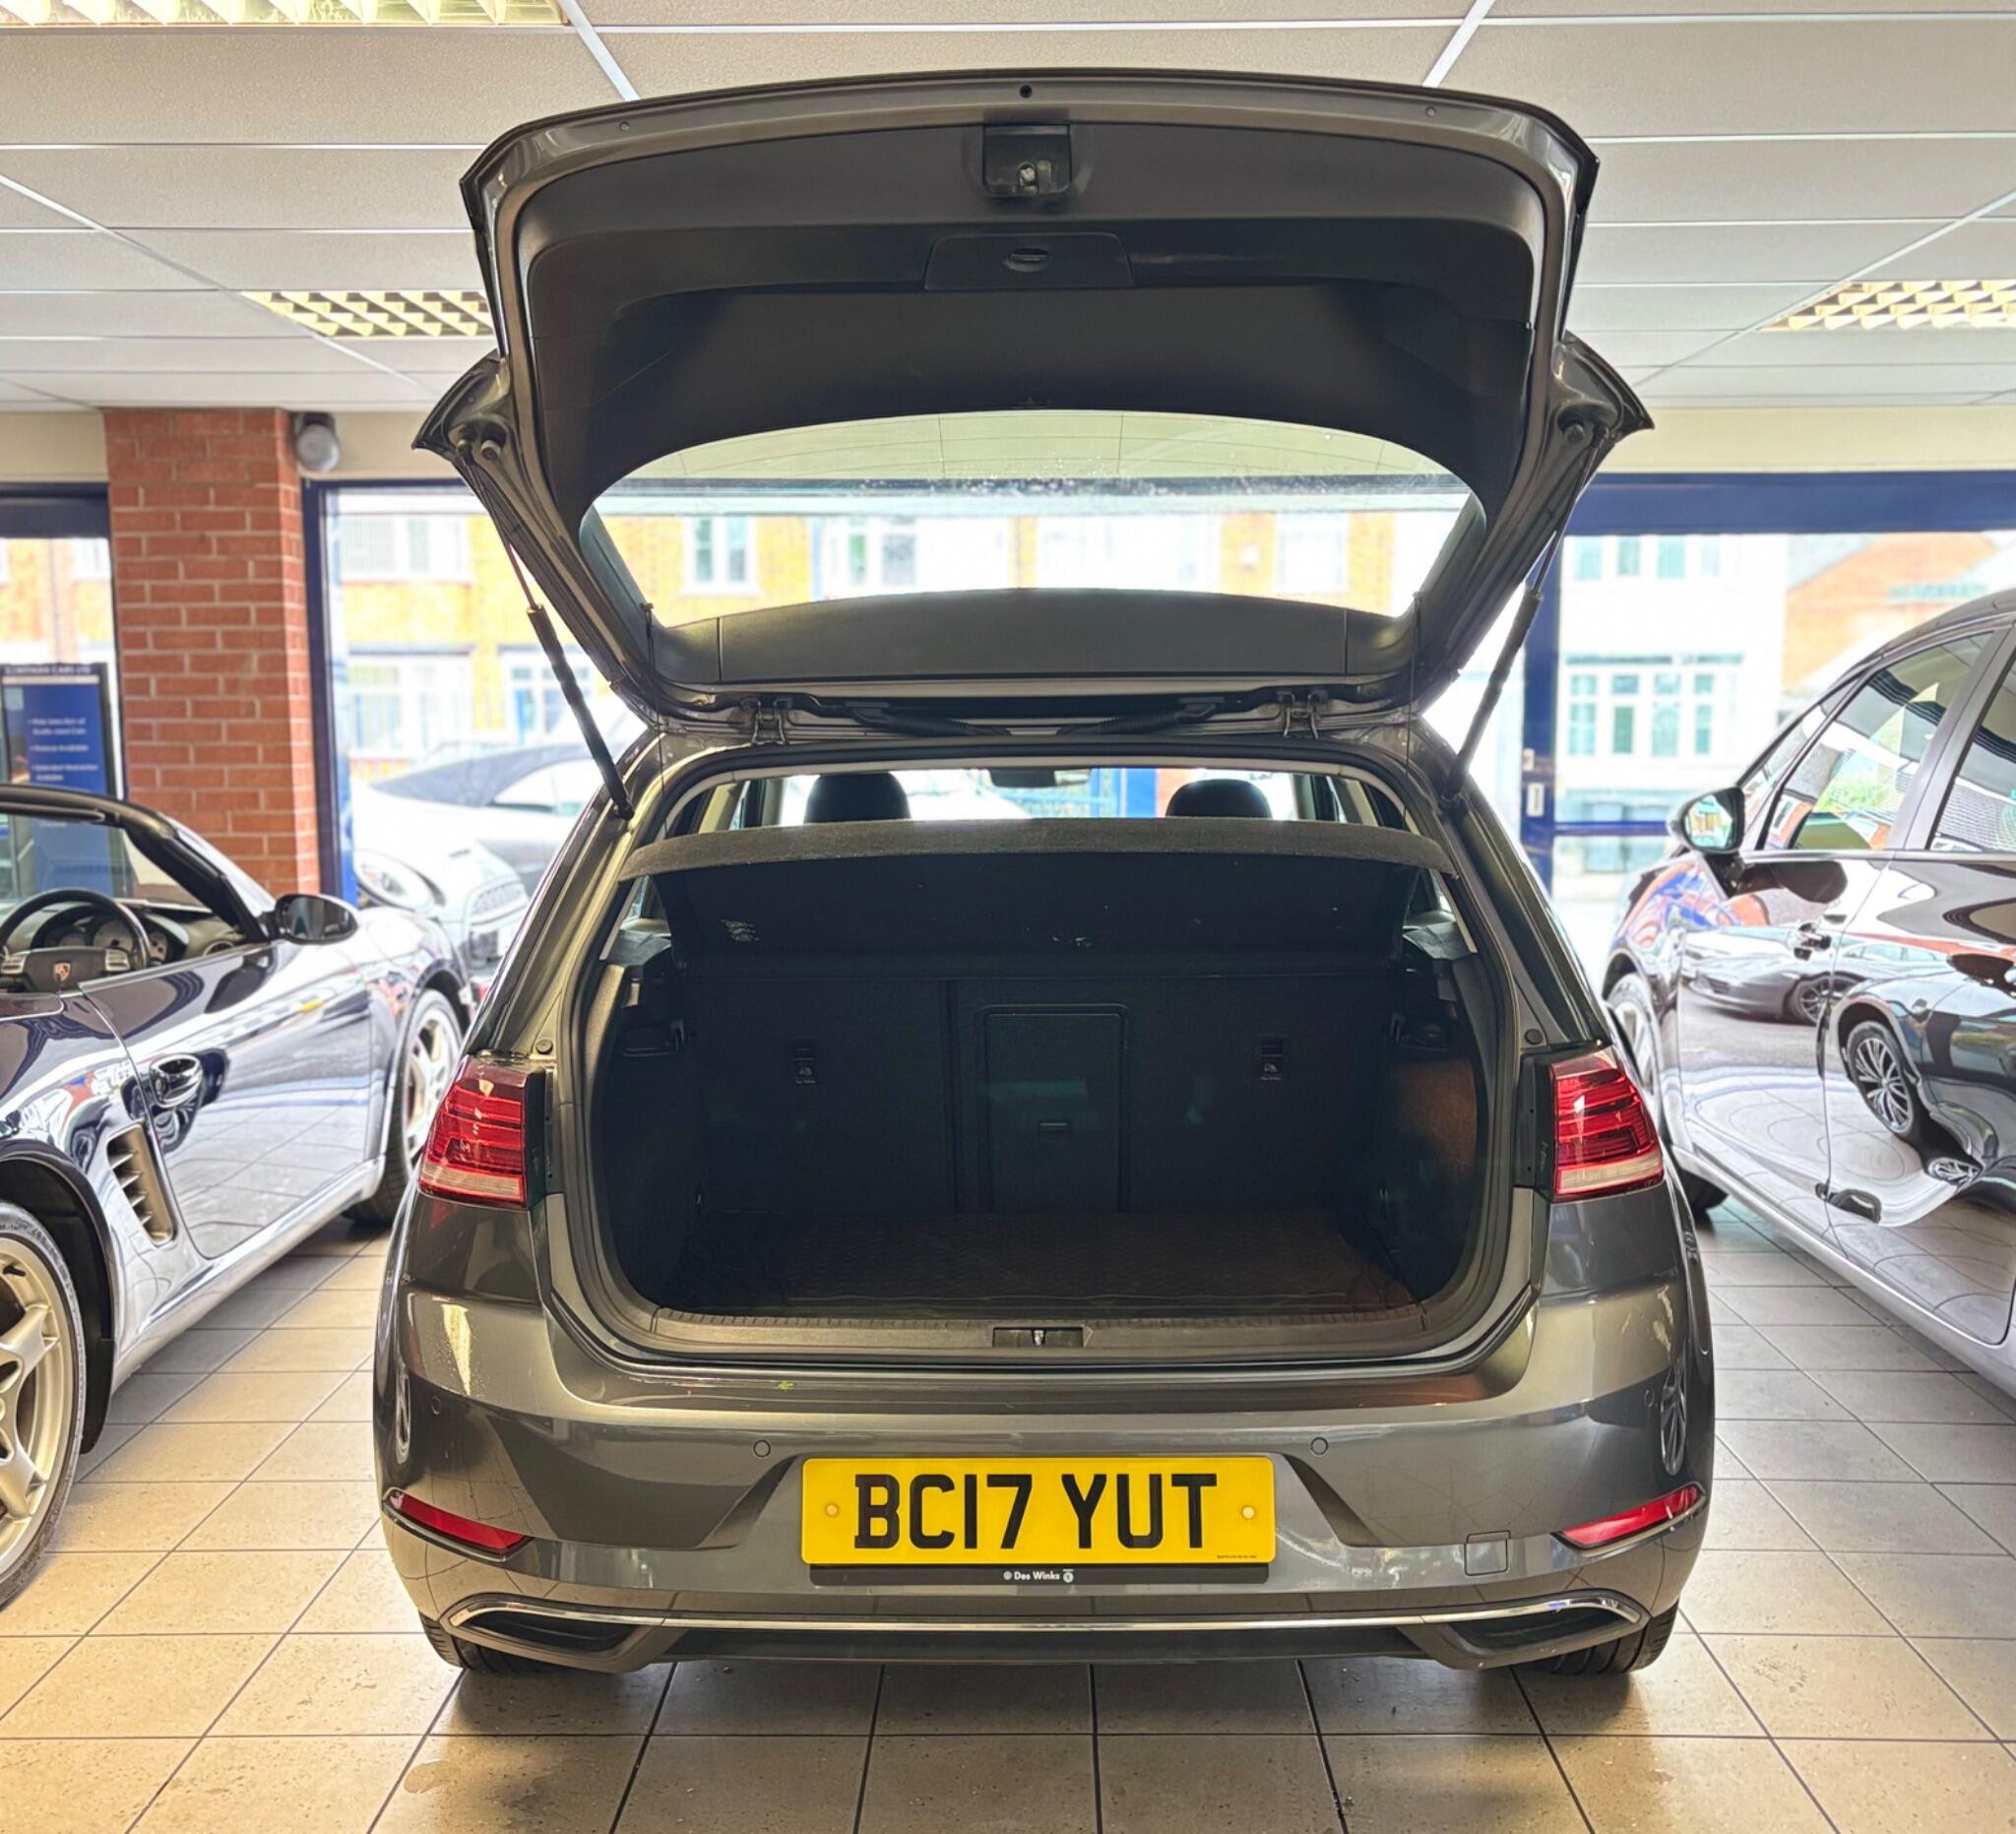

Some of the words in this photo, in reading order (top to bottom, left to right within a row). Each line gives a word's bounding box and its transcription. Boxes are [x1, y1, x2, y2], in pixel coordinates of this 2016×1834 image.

[853, 1473, 1033, 1549] BC17
[1061, 1473, 1218, 1549] YUT
[1032, 1569, 1060, 1580] Winks
